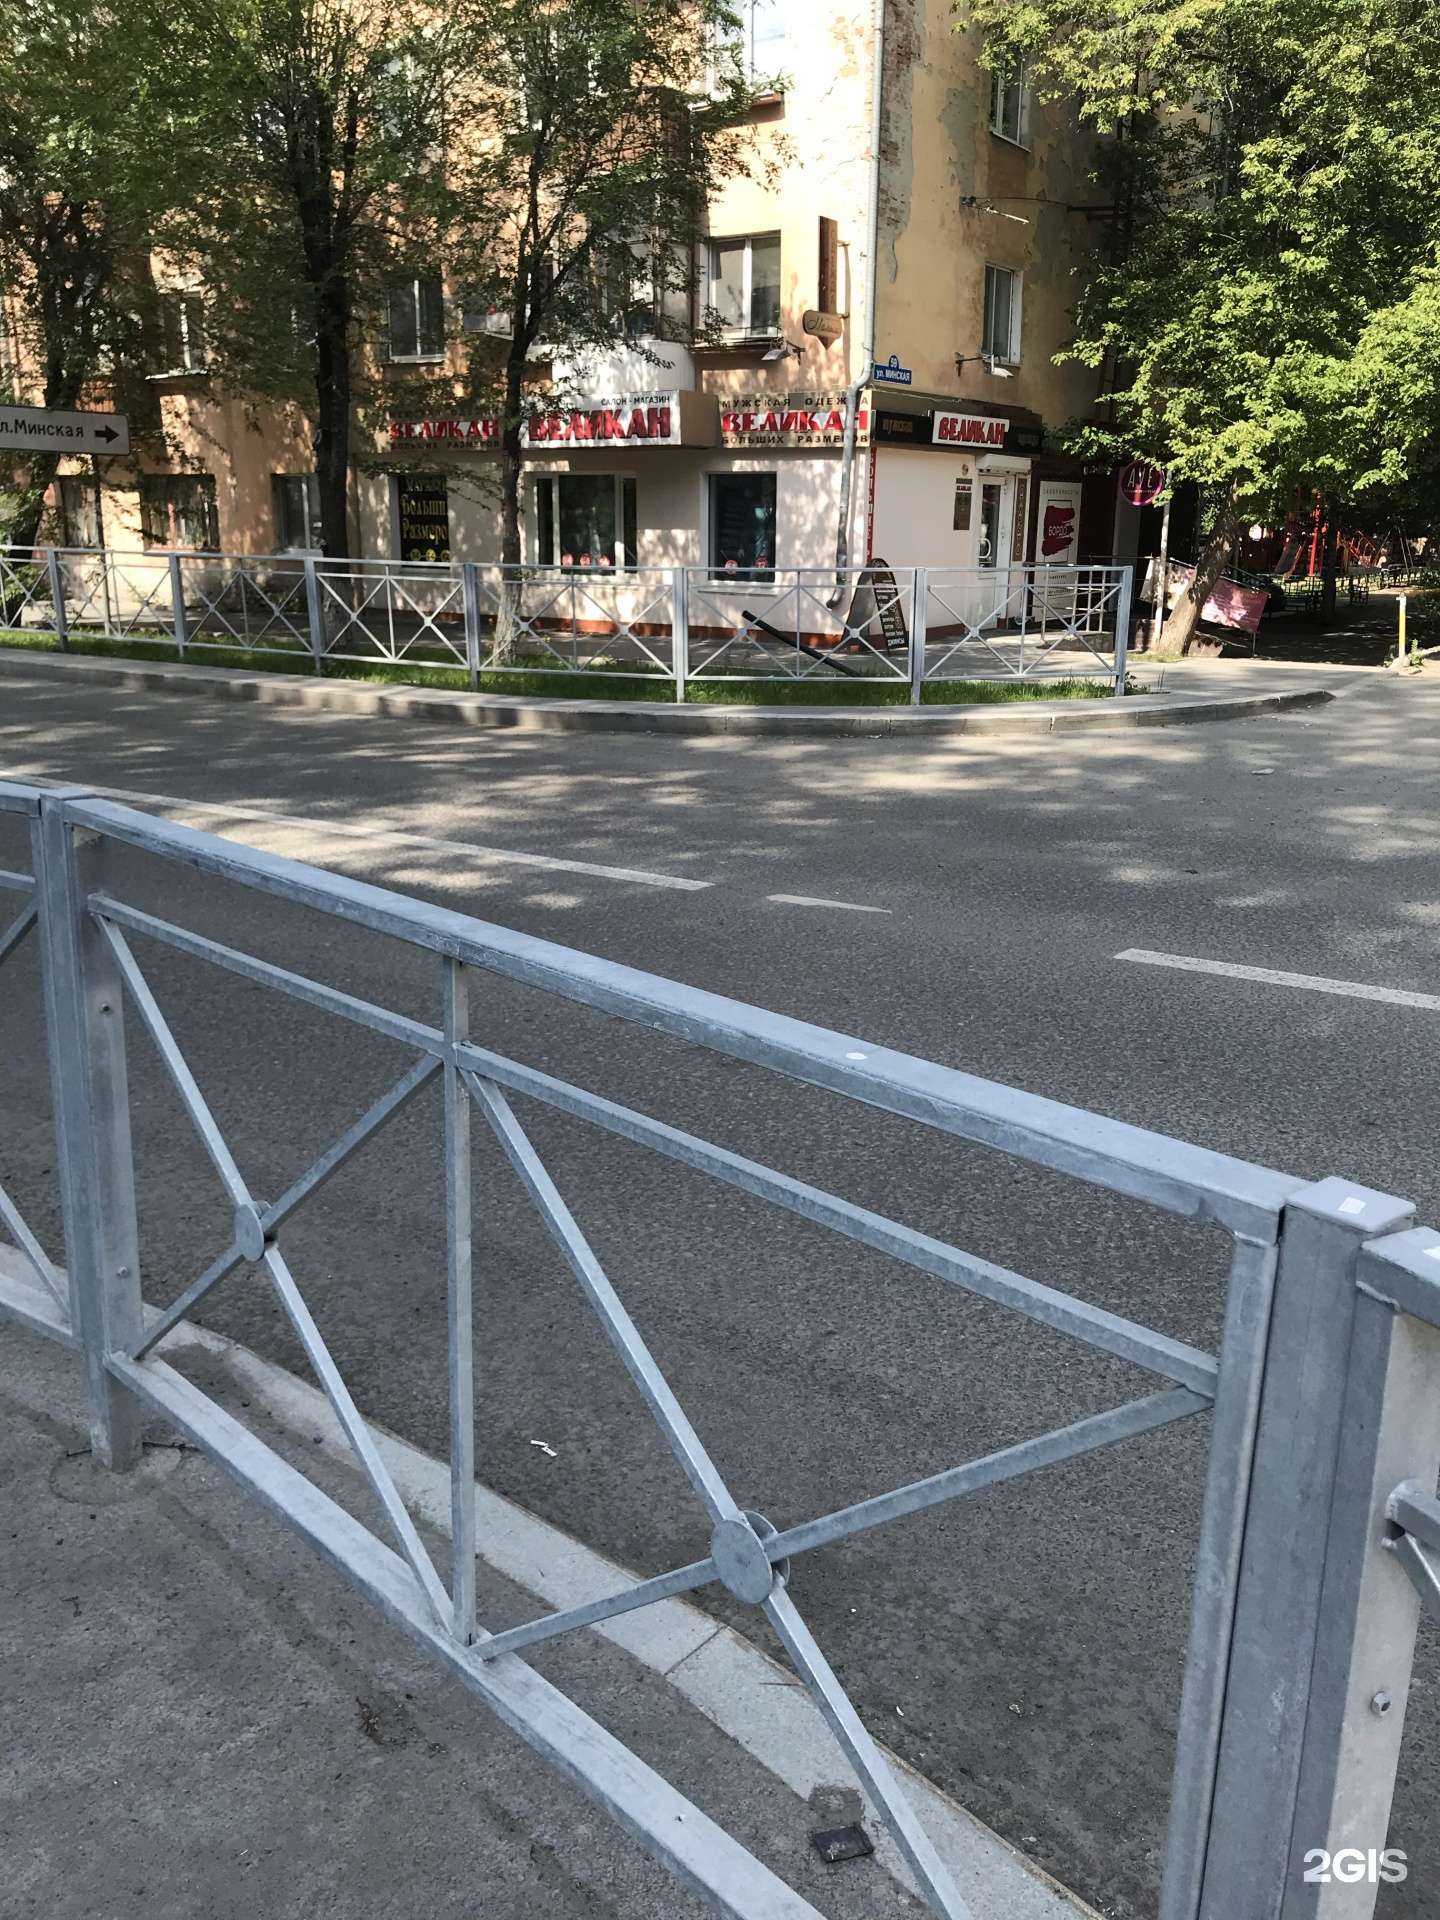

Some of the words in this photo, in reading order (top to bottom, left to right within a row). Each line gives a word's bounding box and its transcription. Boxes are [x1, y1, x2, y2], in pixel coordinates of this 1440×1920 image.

[634, 396, 670, 405] МАГАЗИН
[722, 398, 791, 409] МУЖСКАЯ
[805, 396, 869, 406] ОДЕЖА
[938, 417, 1005, 444] ВЕЛИКАН
[721, 435, 784, 444] БОЛЬШИХ
